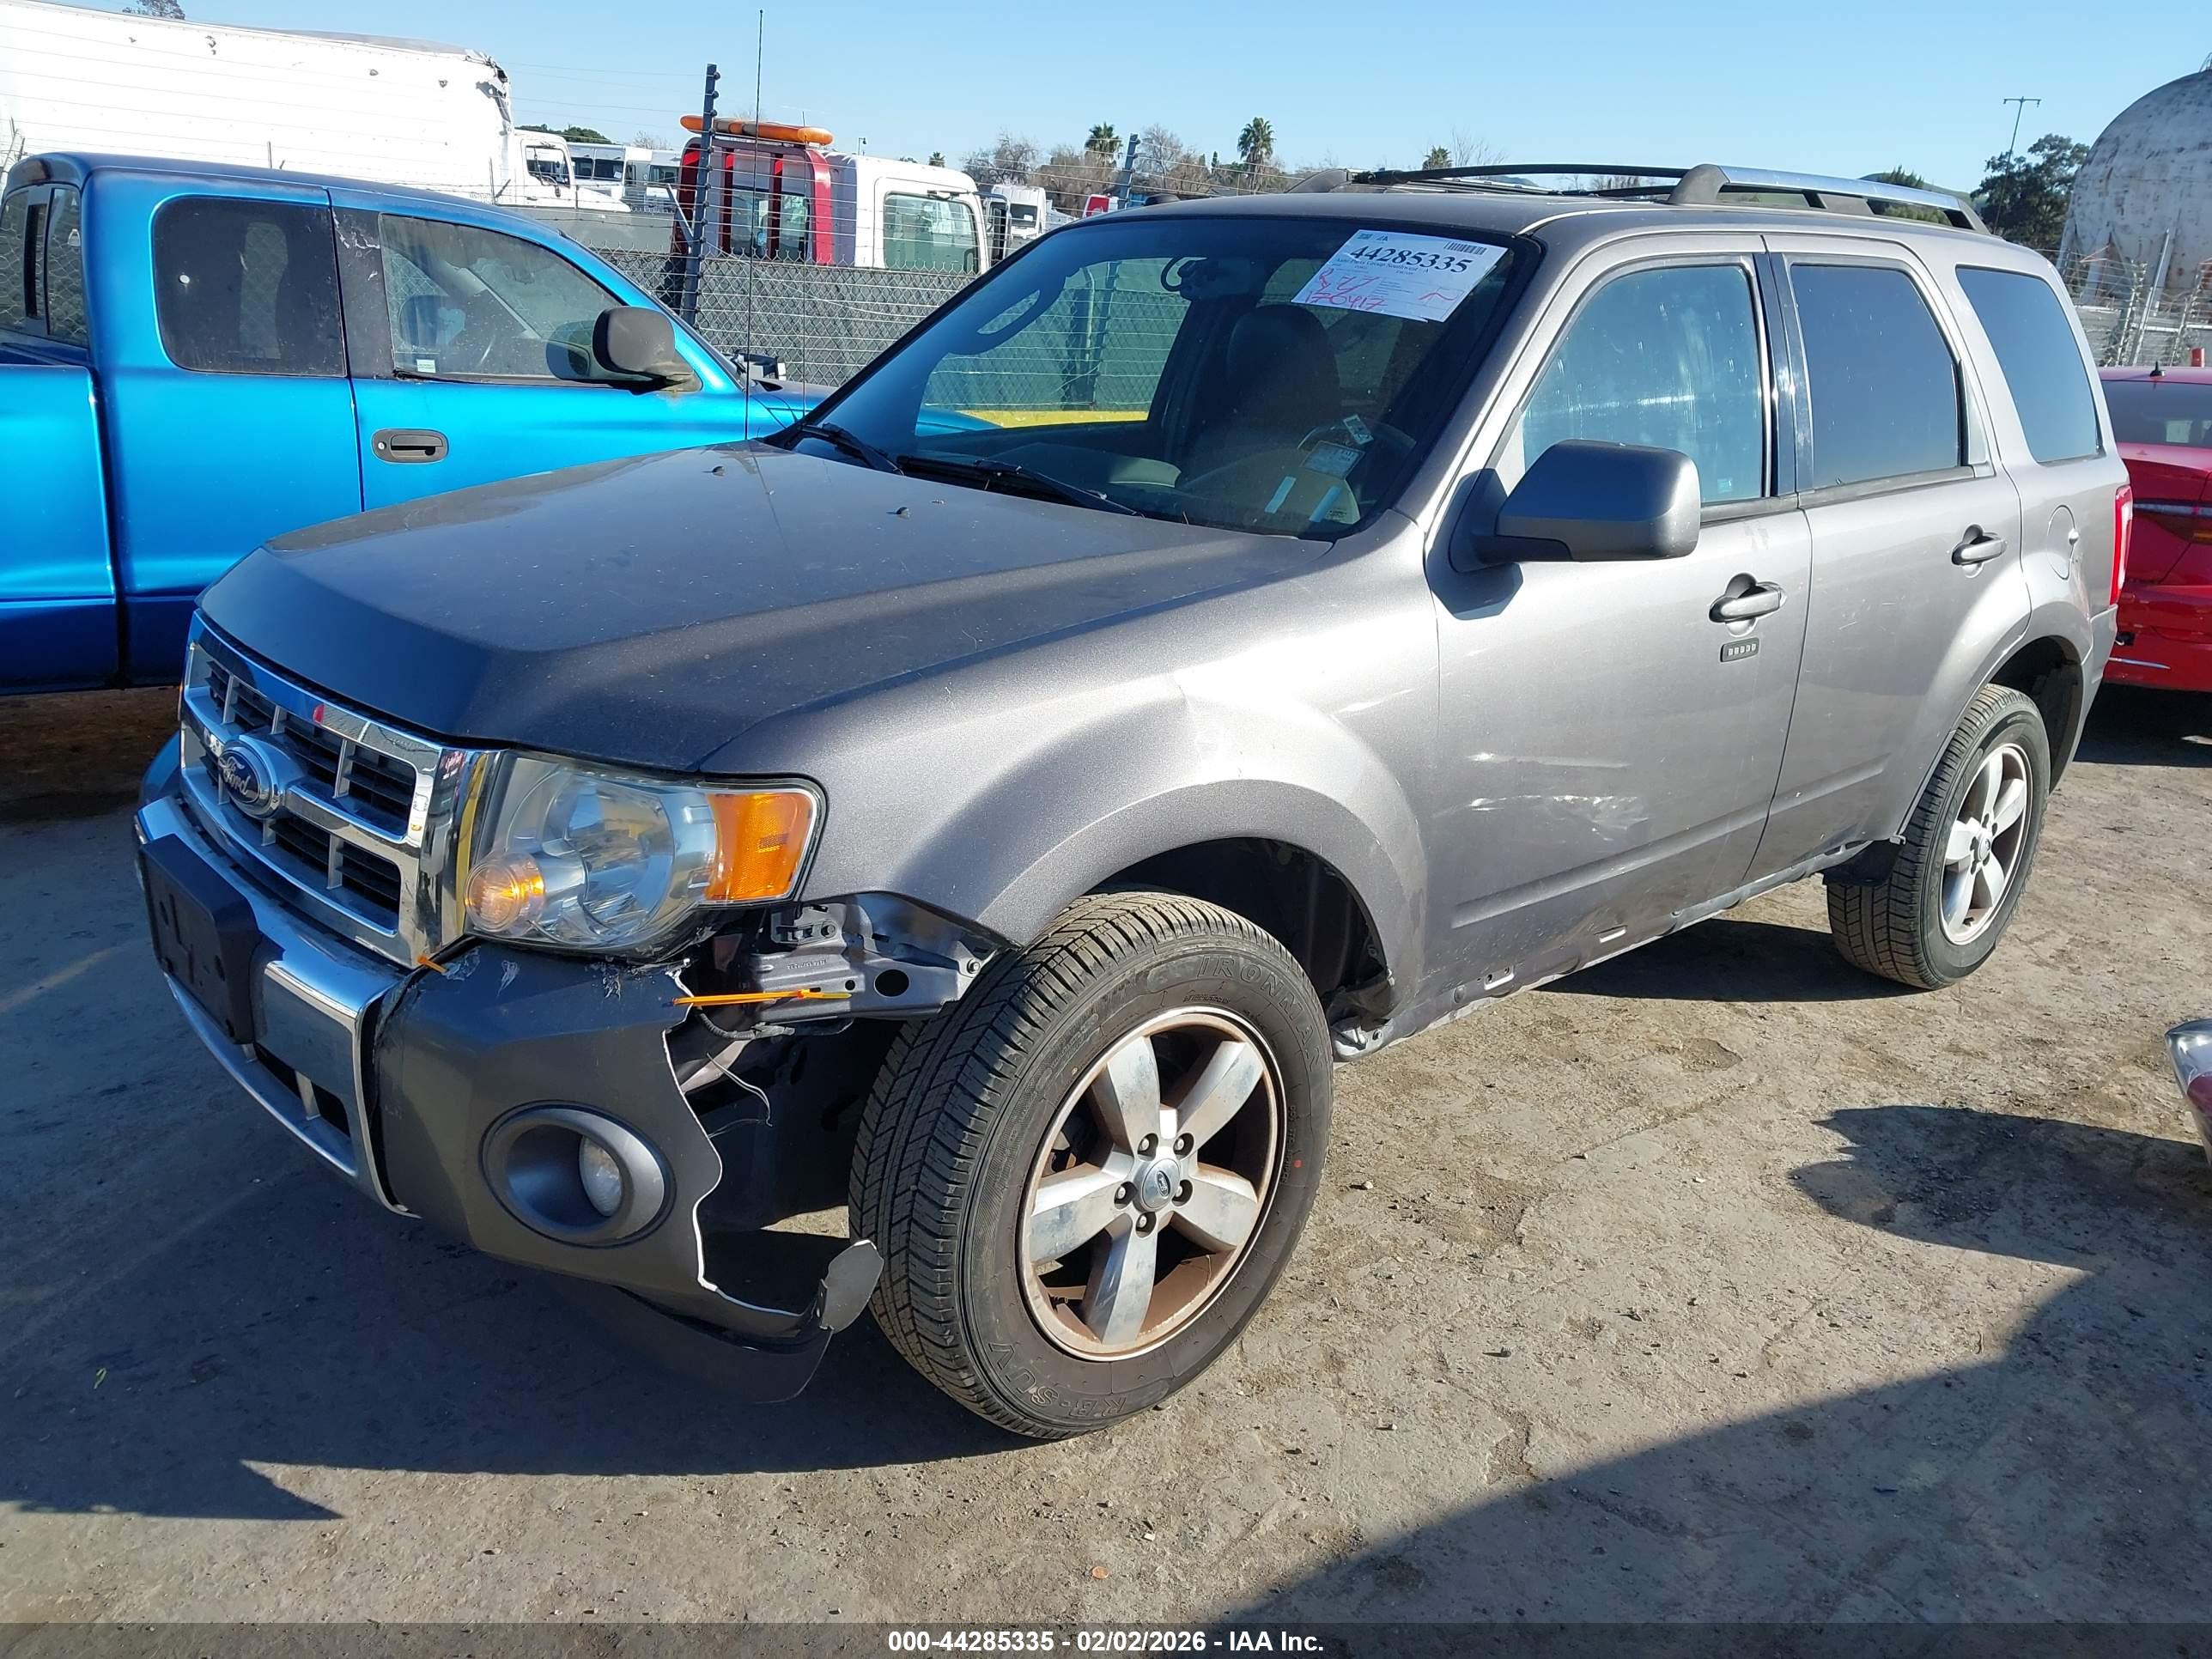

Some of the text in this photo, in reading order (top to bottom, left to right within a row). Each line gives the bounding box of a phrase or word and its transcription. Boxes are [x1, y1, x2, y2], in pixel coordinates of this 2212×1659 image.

[1350, 246, 1474, 273] 44285335
[218, 756, 251, 796] Ford
[1196, 955, 1324, 1073] IRONMAN
